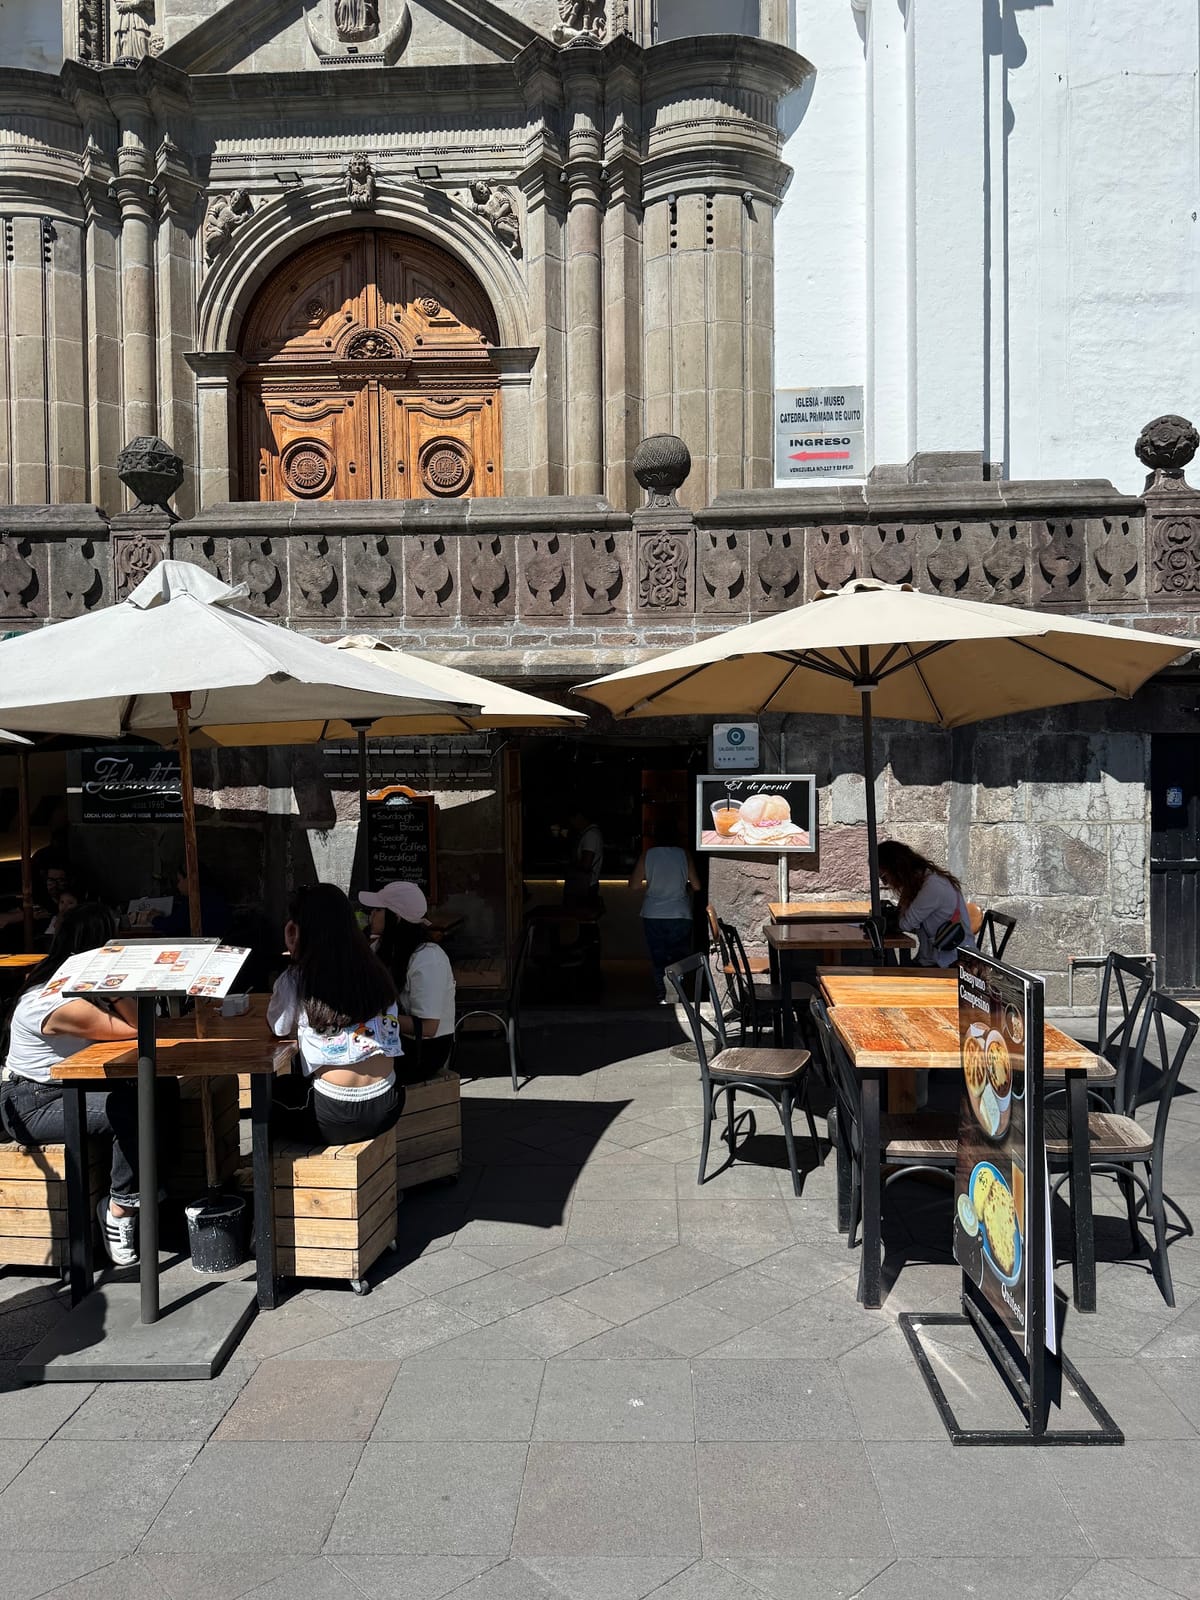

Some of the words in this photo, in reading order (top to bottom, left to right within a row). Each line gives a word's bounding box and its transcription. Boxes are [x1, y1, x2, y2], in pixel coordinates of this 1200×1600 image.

[796, 397, 819, 408] IGLESIA
[824, 395, 846, 407] MUSEO
[780, 412, 808, 423] CATEDRAL
[809, 411, 834, 422] PRIMADA
[835, 410, 842, 420] DE
[843, 410, 861, 420] QUITO
[789, 437, 851, 447] INGRESO
[724, 779, 743, 791] El
[746, 781, 758, 790] de
[757, 781, 792, 794] pernil
[959, 965, 986, 991] Desayuno
[959, 984, 990, 1014] Campesino
